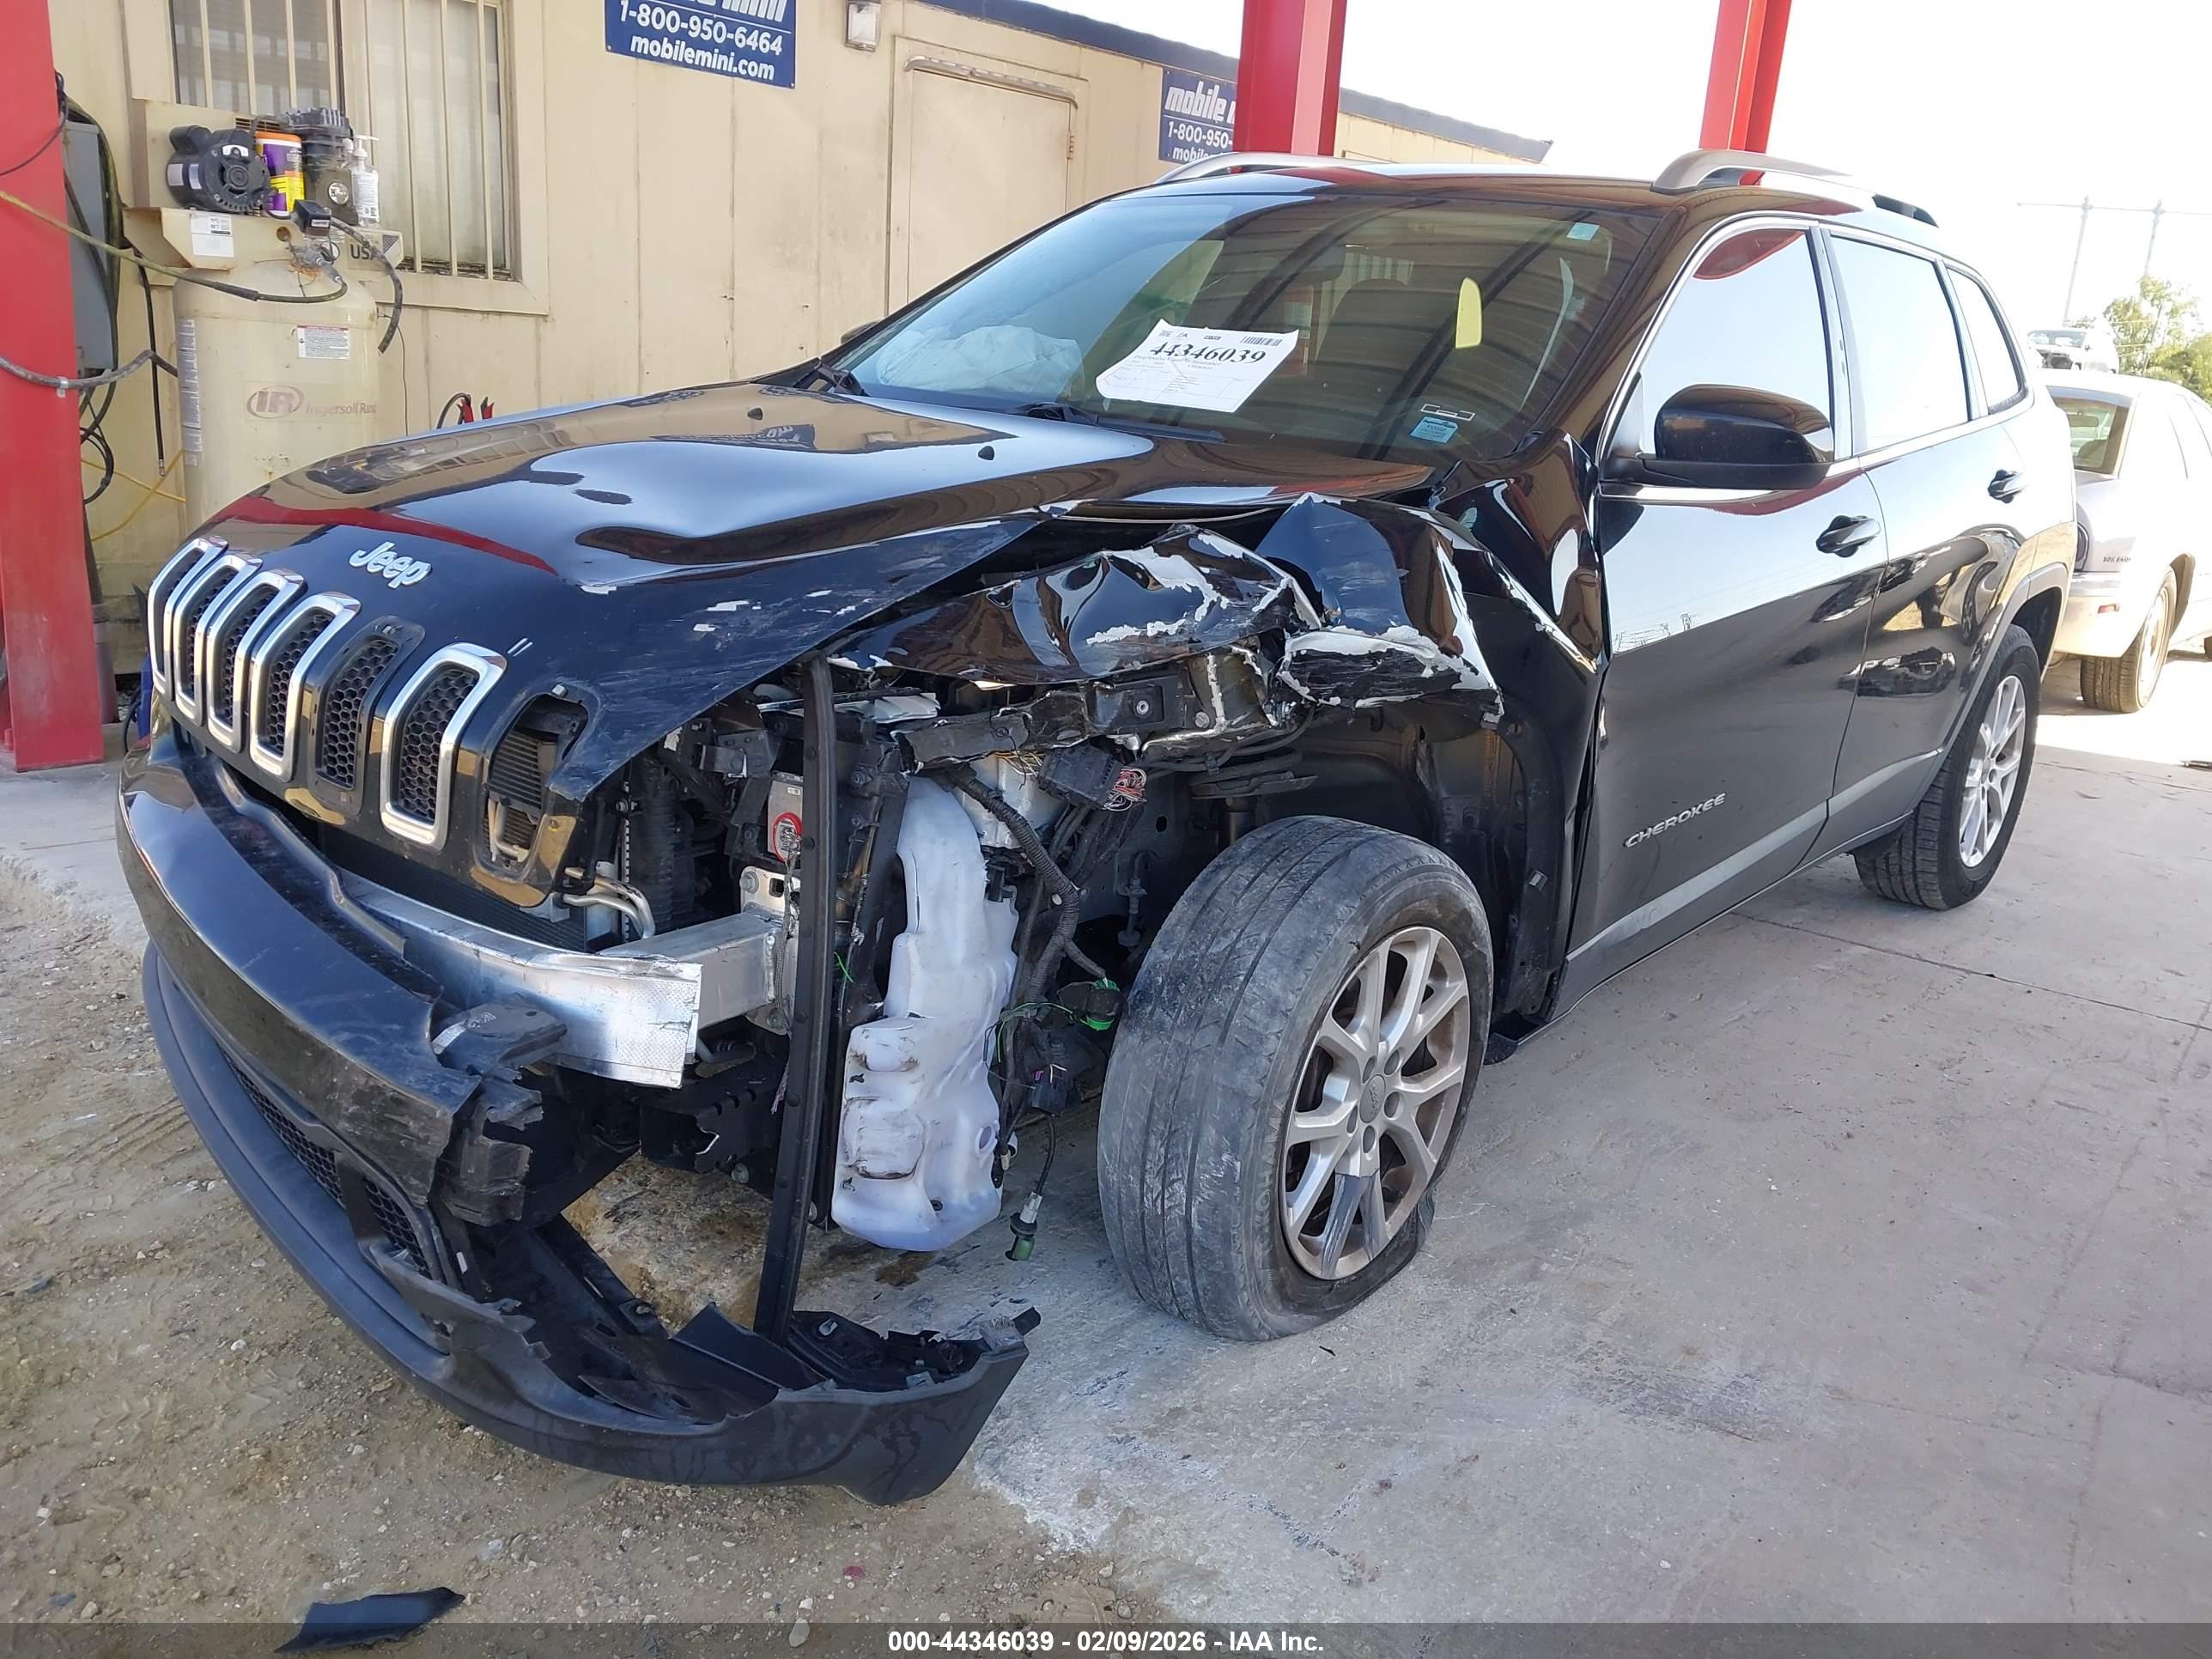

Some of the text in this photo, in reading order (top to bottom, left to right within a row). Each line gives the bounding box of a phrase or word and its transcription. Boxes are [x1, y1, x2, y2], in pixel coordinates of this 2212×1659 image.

[620, 0, 783, 56] 1-800-950-6464
[629, 34, 775, 81] mobilemini.com
[1164, 81, 1228, 122] mobile
[1168, 121, 1233, 149] 1-800-950-
[1150, 341, 1267, 364] 44346039
[349, 541, 431, 589] Jeep
[1625, 793, 1726, 848] CHEROKEE
